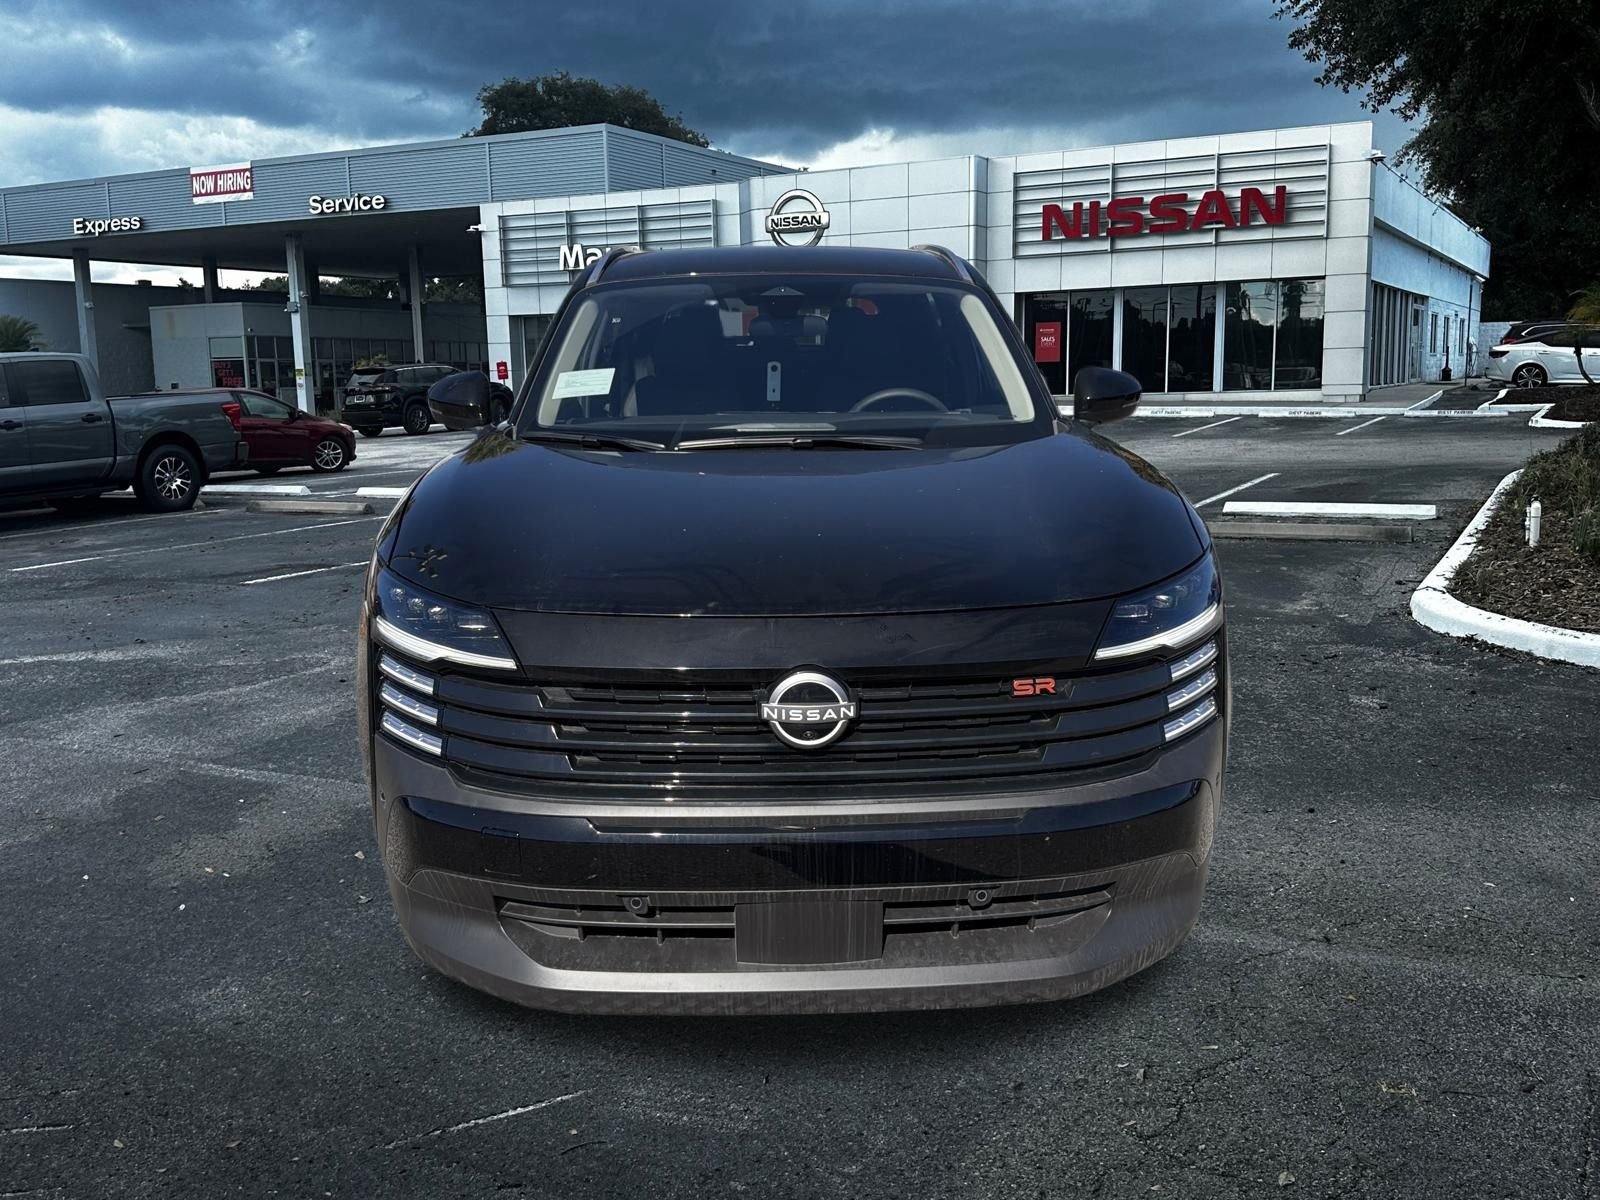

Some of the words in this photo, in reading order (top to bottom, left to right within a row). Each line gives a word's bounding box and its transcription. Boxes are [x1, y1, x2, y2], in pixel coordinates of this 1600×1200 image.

[192, 174, 216, 195] NOW
[216, 171, 251, 193] HIRING
[308, 192, 386, 215] Service
[1041, 185, 1287, 241] NISSAN
[73, 216, 141, 237] Express
[770, 214, 822, 229] NISSAN
[1013, 678, 1057, 696] SR
[763, 705, 854, 721] NISSAN
